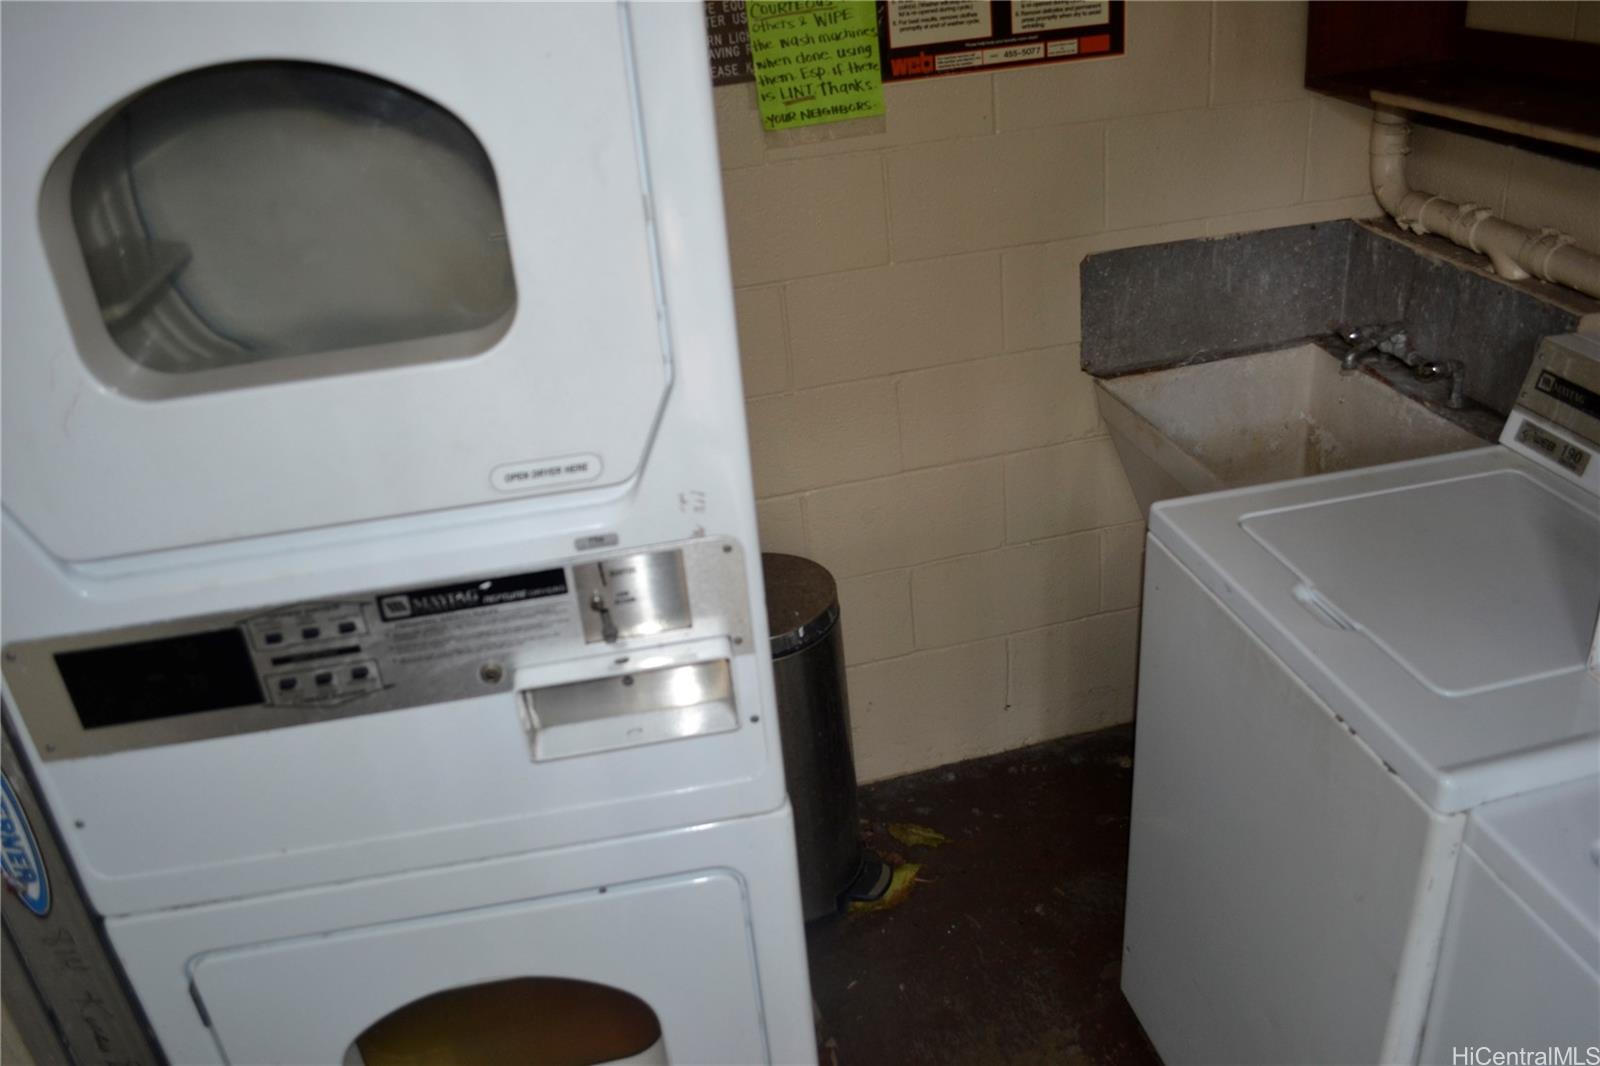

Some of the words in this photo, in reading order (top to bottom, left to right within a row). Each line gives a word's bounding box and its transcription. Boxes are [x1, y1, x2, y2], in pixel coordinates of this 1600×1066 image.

[722, 0, 745, 13] EQU
[752, 18, 794, 33] others
[815, 9, 852, 27] WIPE
[728, 32, 750, 44] LIG
[753, 40, 773, 52] the
[780, 34, 815, 48] wash
[819, 27, 878, 43] machines
[756, 55, 791, 70] when
[796, 51, 829, 64] done
[837, 44, 872, 58] using
[711, 63, 739, 79] EASE
[759, 71, 793, 87] them
[832, 65, 843, 76] if
[848, 62, 879, 73] there
[761, 92, 775, 102] is
[766, 112, 796, 128] YOUR
[504, 472, 529, 484] OPEN
[531, 467, 562, 480] DRYER
[565, 463, 588, 474] HERE
[413, 587, 479, 609] MAYTAG
